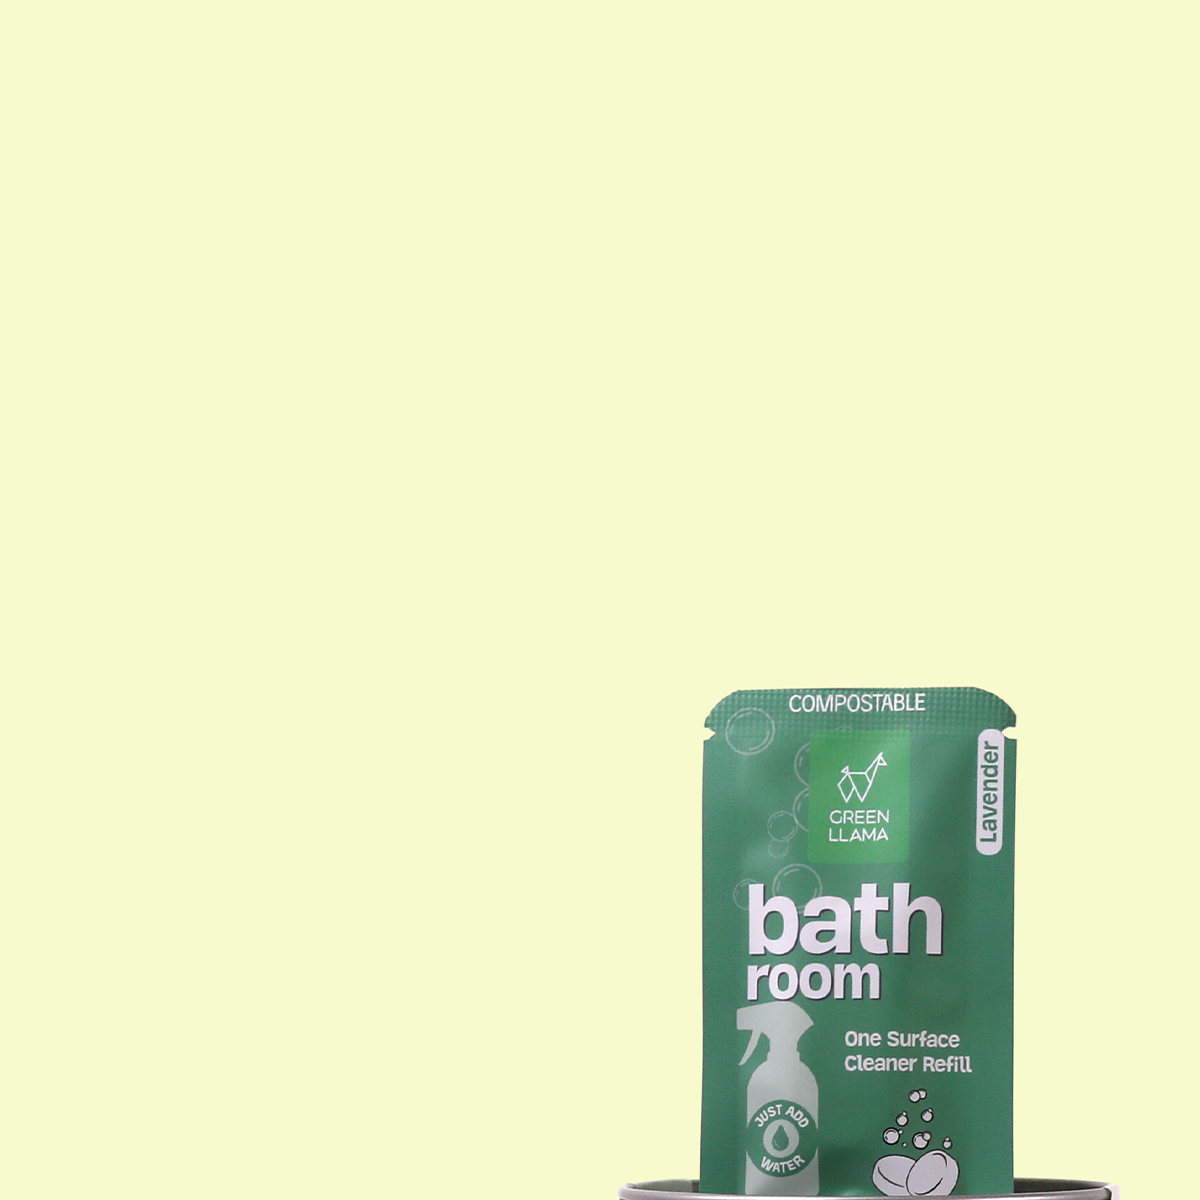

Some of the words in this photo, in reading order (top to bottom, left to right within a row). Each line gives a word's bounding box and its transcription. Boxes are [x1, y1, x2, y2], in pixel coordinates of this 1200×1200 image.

[789, 692, 926, 714] COMPOSTABLE
[978, 740, 999, 844] Lavender
[829, 809, 889, 825] GREEN
[828, 827, 889, 842] LLAMA
[748, 882, 943, 955] bath
[747, 963, 881, 1000] room
[844, 1030, 881, 1047] One
[887, 1030, 960, 1048] Surface
[844, 1055, 917, 1073] Cleaner
[923, 1056, 972, 1073] Refill
[754, 1103, 783, 1128] JUST
[784, 1104, 809, 1129] ADD
[760, 1154, 806, 1175] WATER
